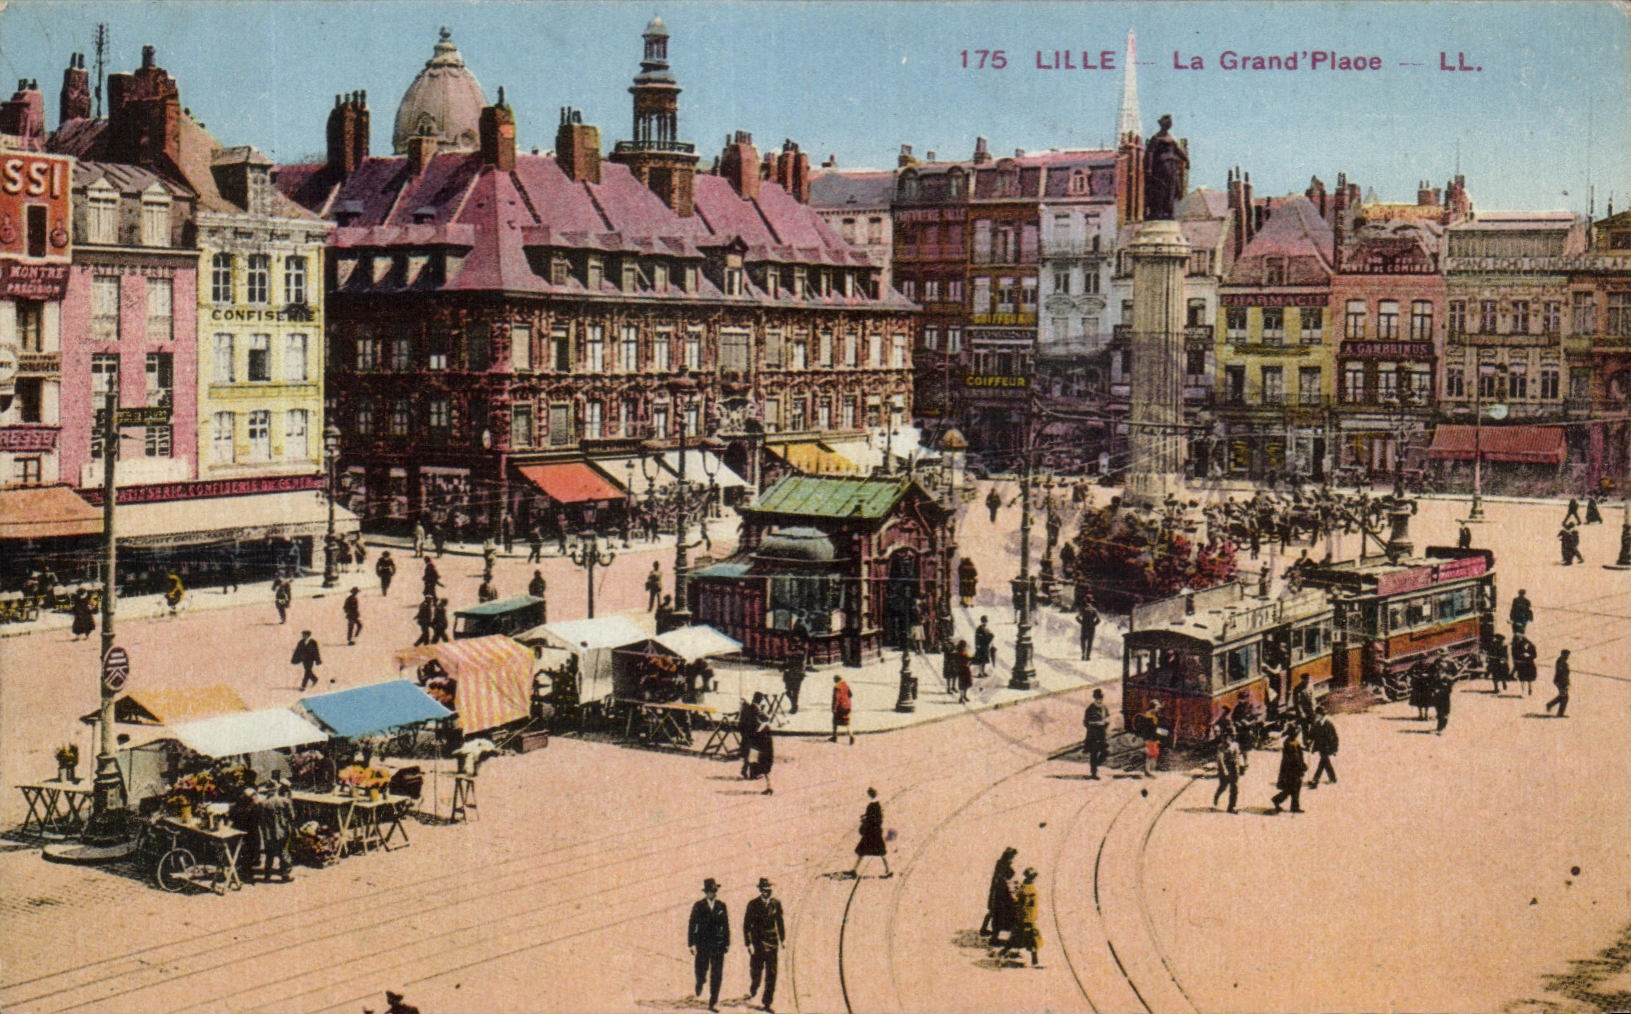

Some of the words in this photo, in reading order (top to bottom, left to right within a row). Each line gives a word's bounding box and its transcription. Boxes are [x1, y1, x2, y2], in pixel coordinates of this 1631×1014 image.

[1223, 295, 1328, 307] PHARMACIE
[211, 309, 315, 322] CONFISERIE
[966, 376, 1025, 387] COIFFEUR
